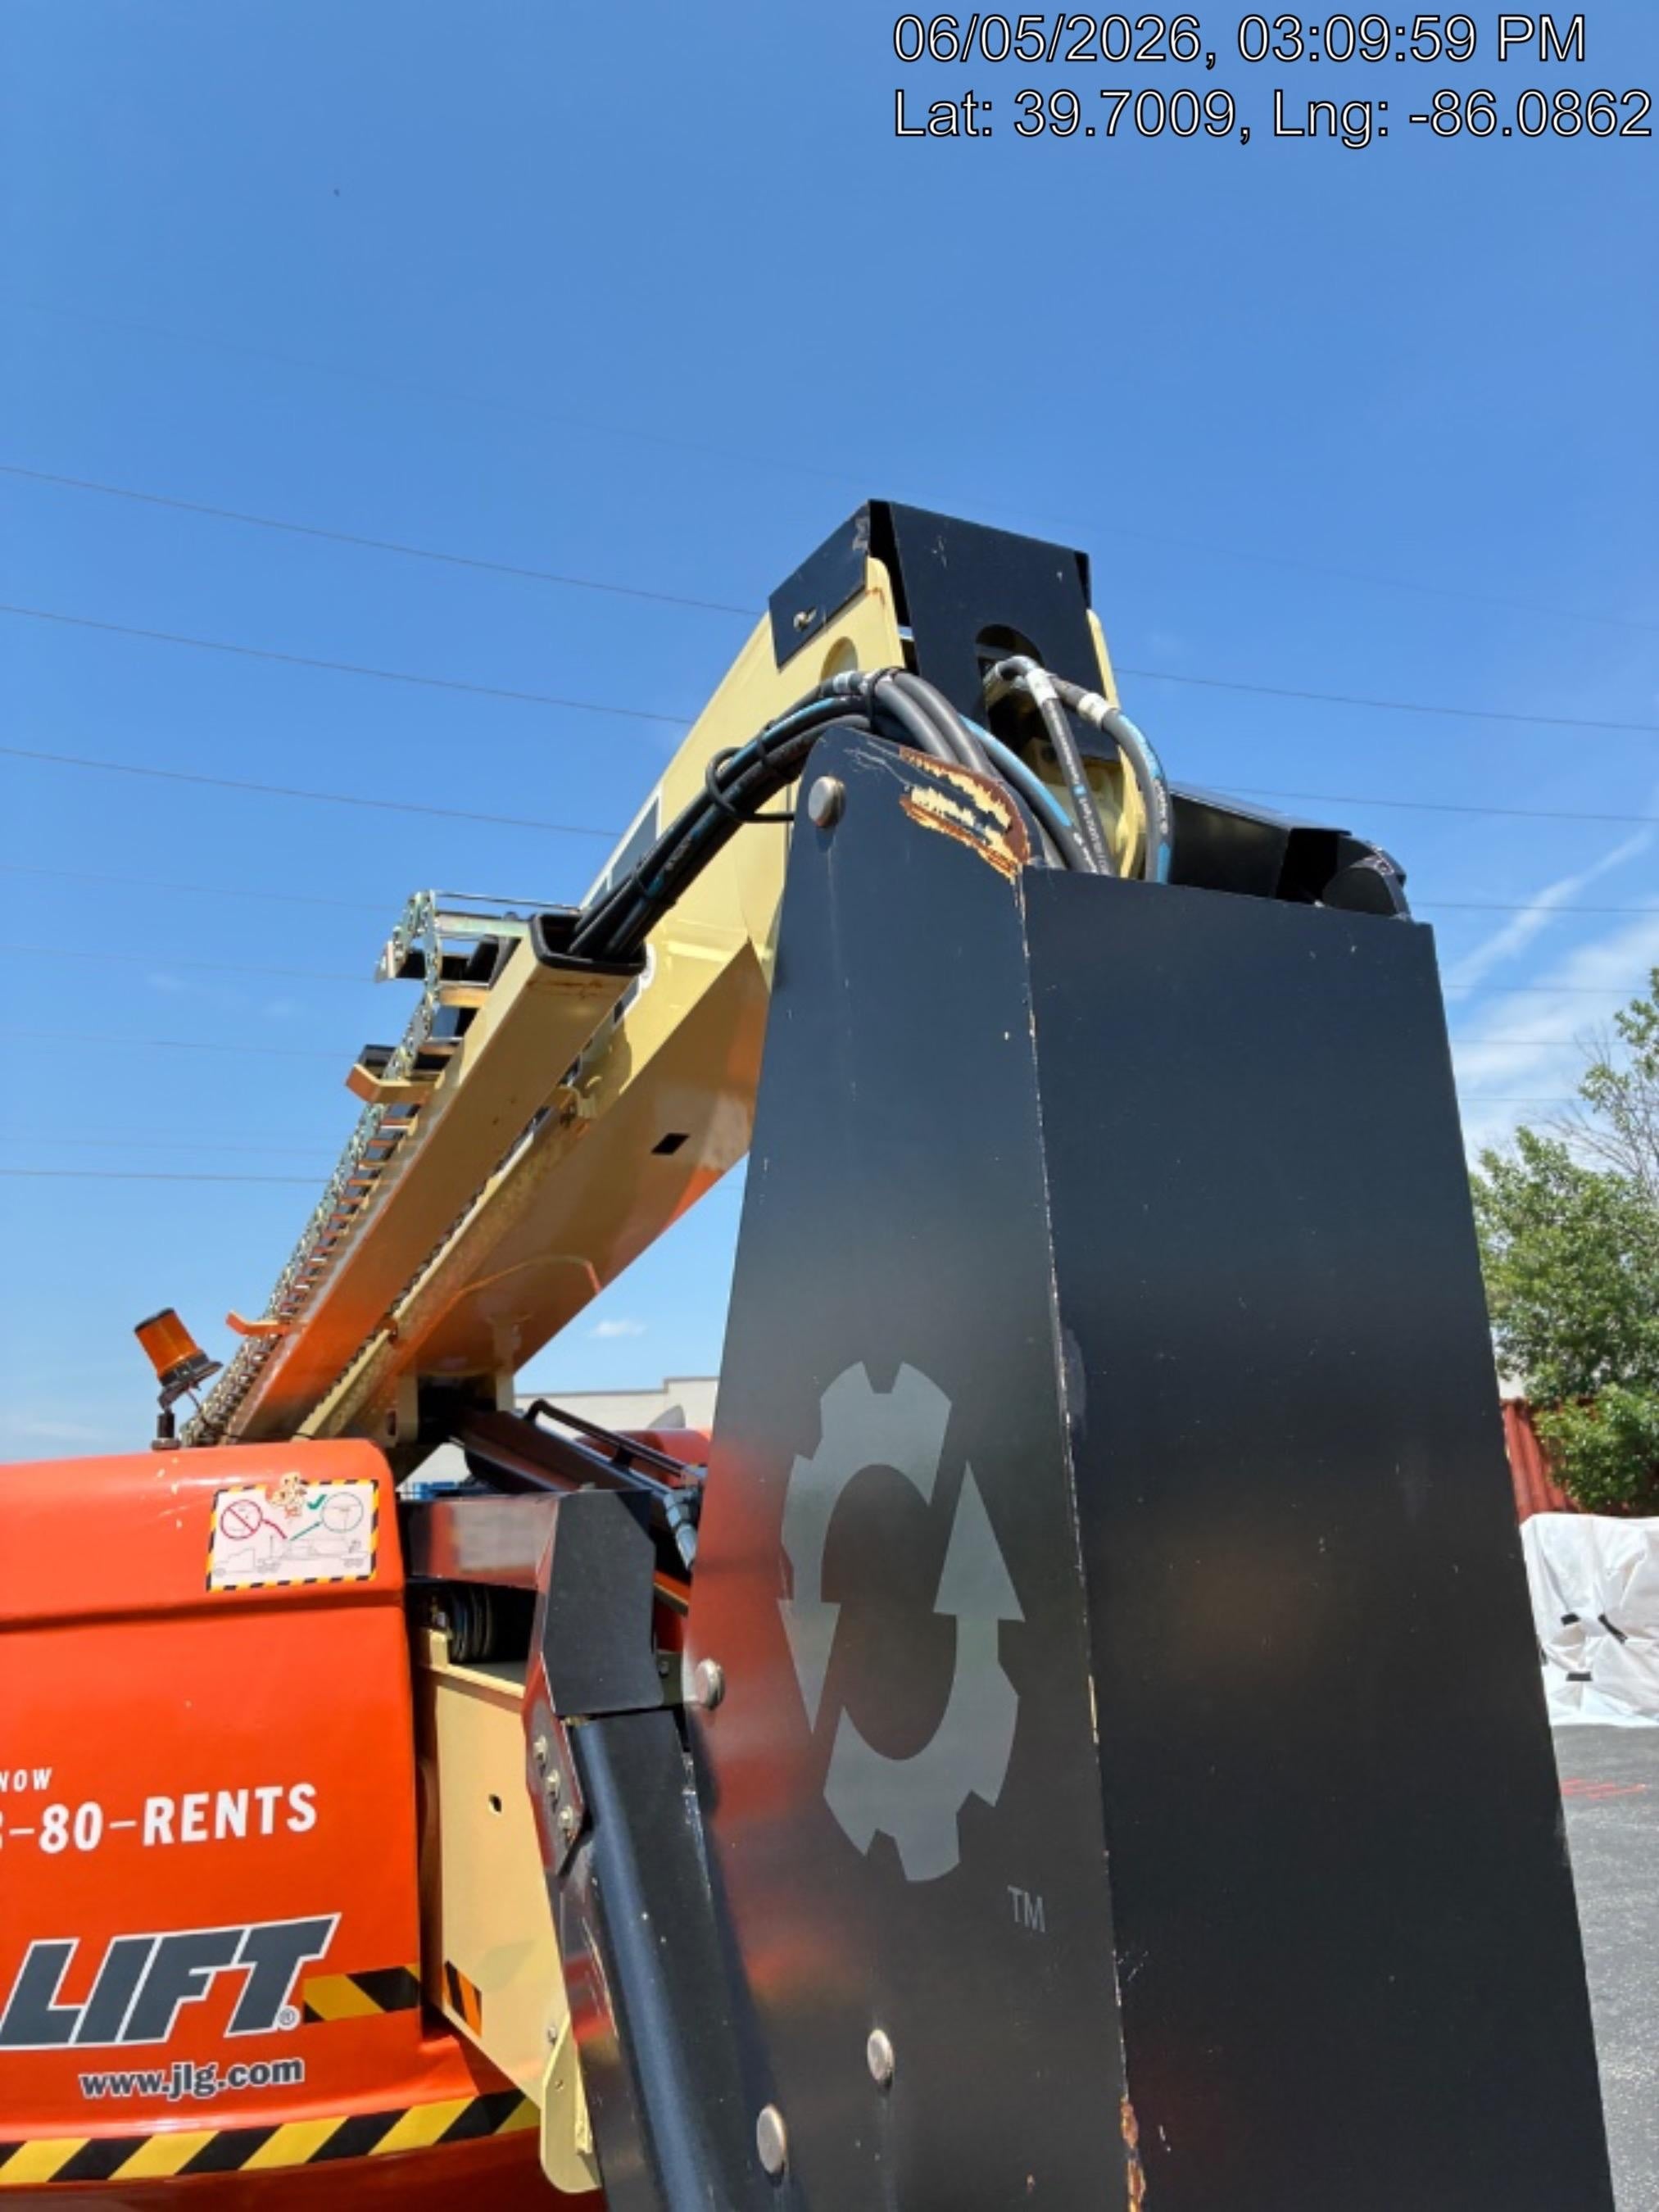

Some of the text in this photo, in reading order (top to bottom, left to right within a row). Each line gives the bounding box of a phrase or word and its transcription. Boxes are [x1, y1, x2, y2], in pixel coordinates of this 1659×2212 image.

[0, 1782, 318, 1854] -80-RENTS
[1007, 1885, 1046, 1932] TM
[79, 2057, 304, 2101] www.jlg.com
